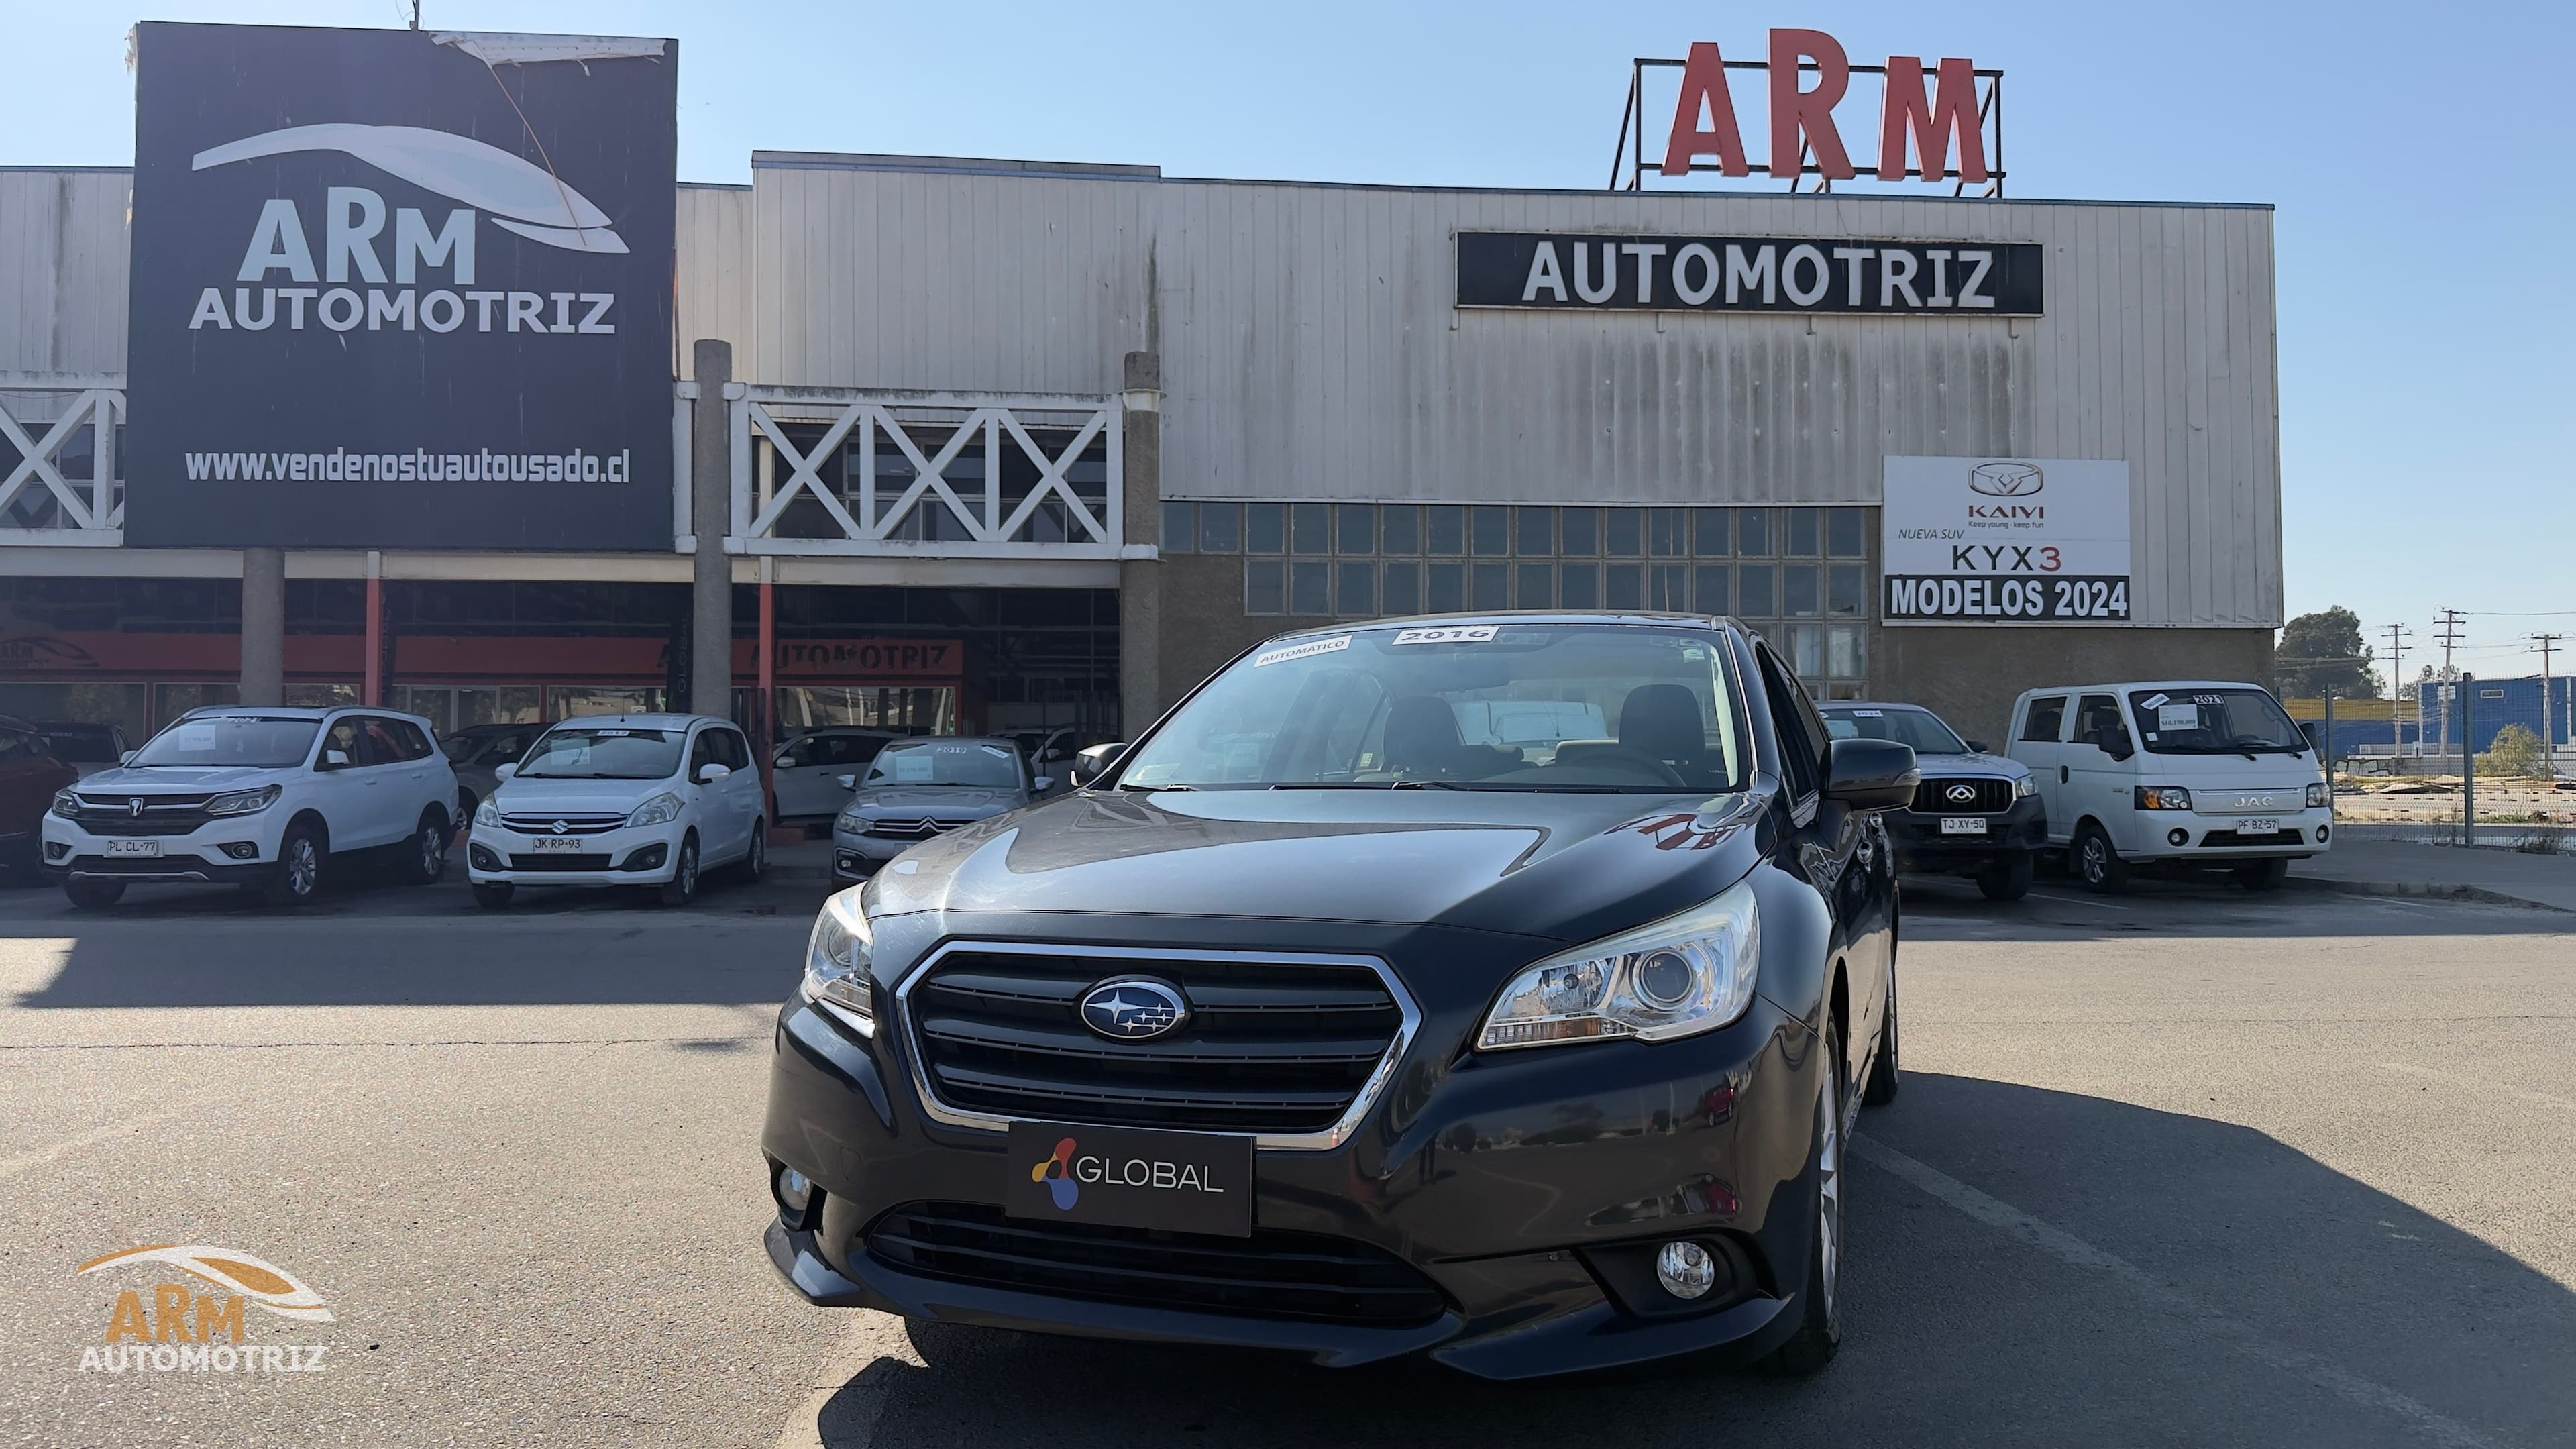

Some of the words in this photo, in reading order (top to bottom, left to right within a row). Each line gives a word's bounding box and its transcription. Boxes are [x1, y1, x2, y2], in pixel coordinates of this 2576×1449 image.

[1660, 28, 1988, 183] ARM
[236, 186, 476, 285] ARM
[1522, 240, 1995, 308] AUTOMOTRIZ
[188, 287, 615, 334] AUTOMOTRIZ
[185, 446, 630, 483] www.vendenostuautousado.cl
[1968, 505, 2044, 518] KAIYI
[1898, 529, 1938, 539] NUEVA
[1941, 529, 1964, 539] SUV
[1968, 521, 1986, 529] Keep
[1988, 521, 2008, 530] young
[2013, 521, 2031, 529] keep
[1952, 545, 2061, 572] KYX3
[1891, 578, 2044, 616] MODELOS
[2054, 580, 2128, 617] 2024
[1402, 629, 1489, 641] 2016
[1260, 639, 1345, 663] AUTOMÁTICO
[2196, 695, 2223, 703] 2021
[2233, 796, 2273, 807] JAC
[1076, 1155, 1224, 1193] GLOBAL
